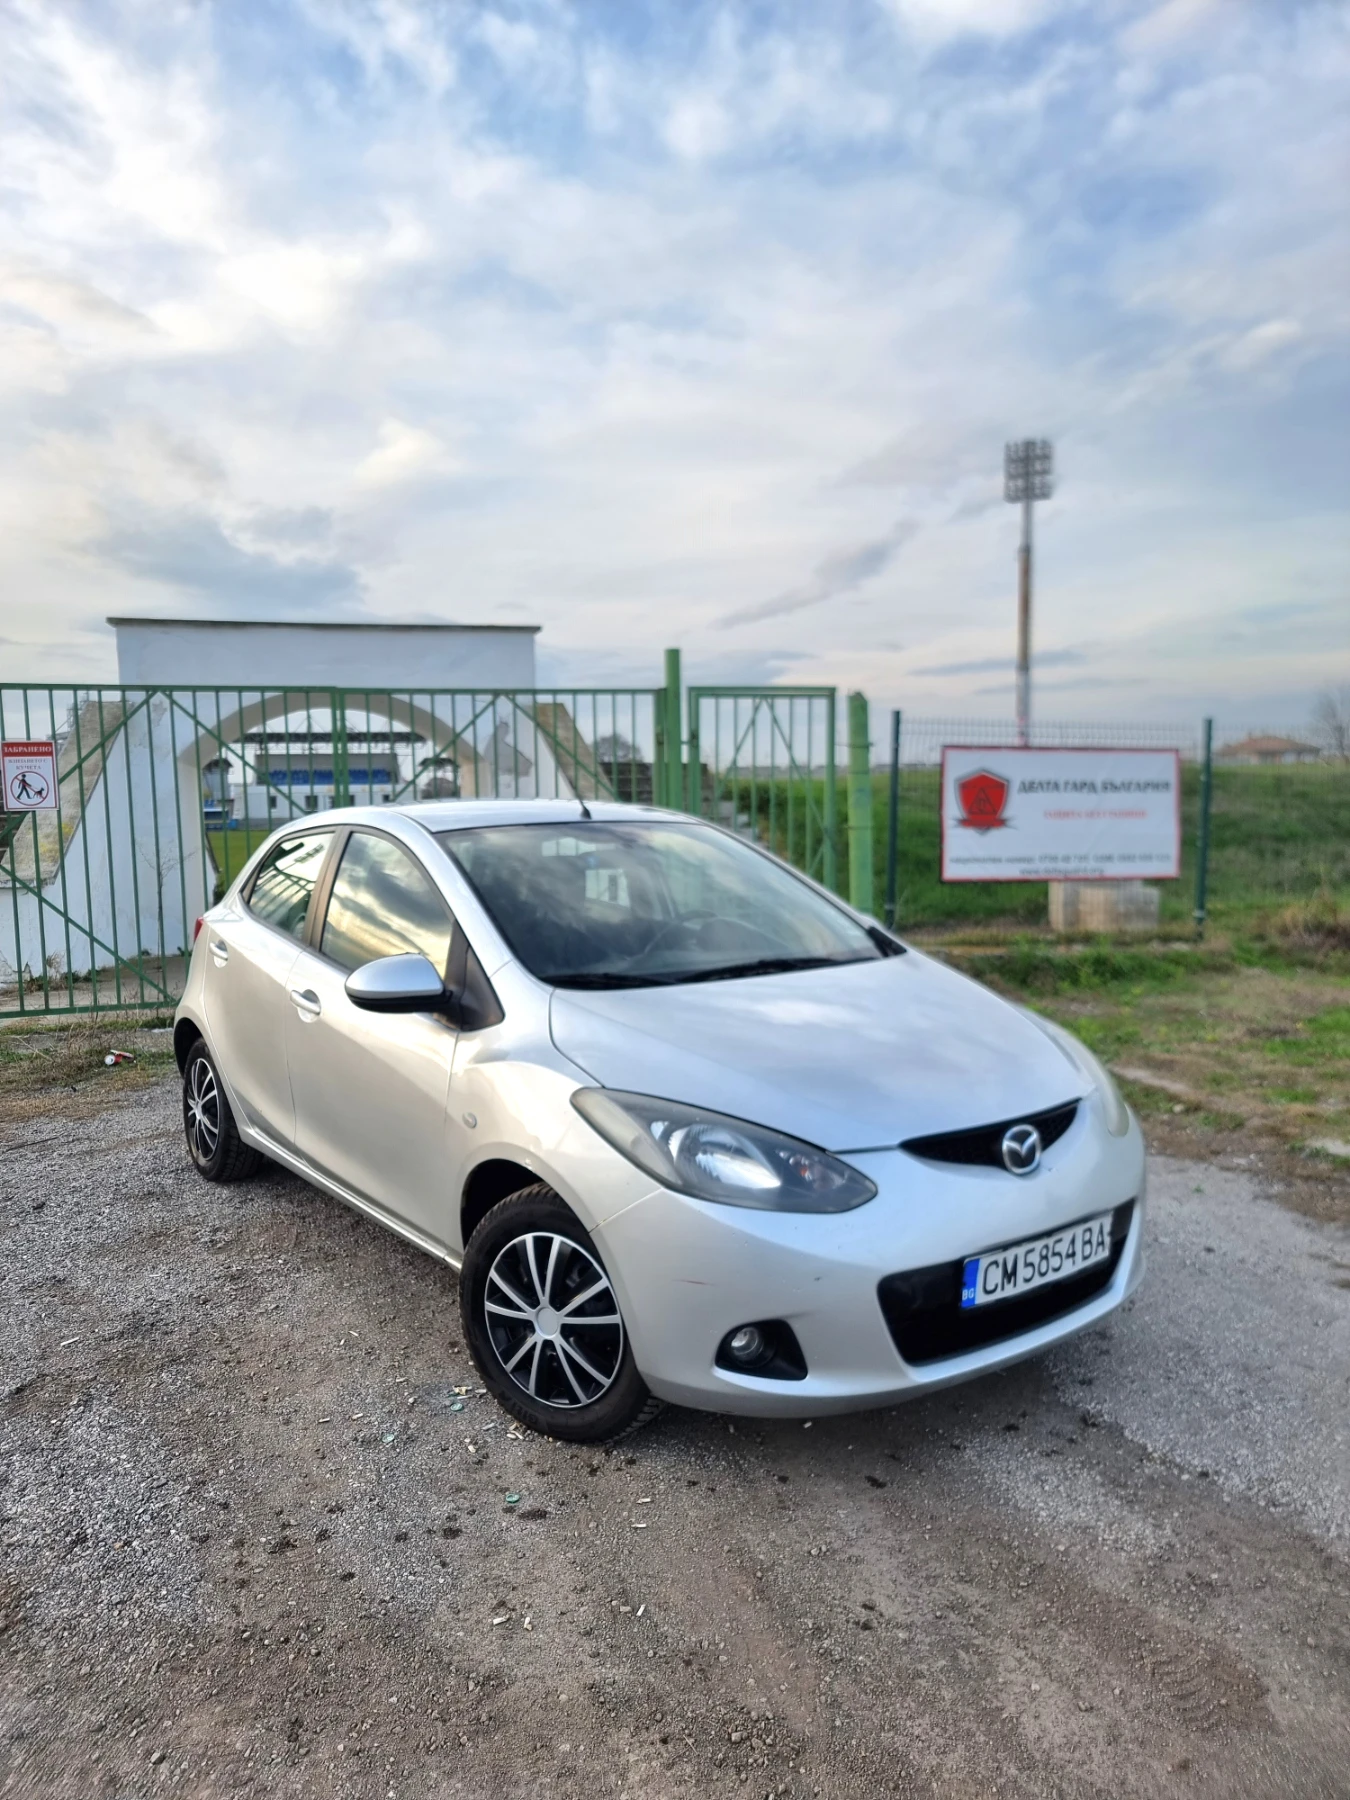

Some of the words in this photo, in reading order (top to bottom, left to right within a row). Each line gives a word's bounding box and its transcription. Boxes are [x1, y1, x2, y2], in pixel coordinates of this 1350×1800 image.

[1017, 780, 1060, 793] ДЕЛТА
[1063, 780, 1097, 794] ГАРД
[1101, 780, 1171, 793] БЪЛГАРИЯ
[962, 1287, 975, 1300] BG
